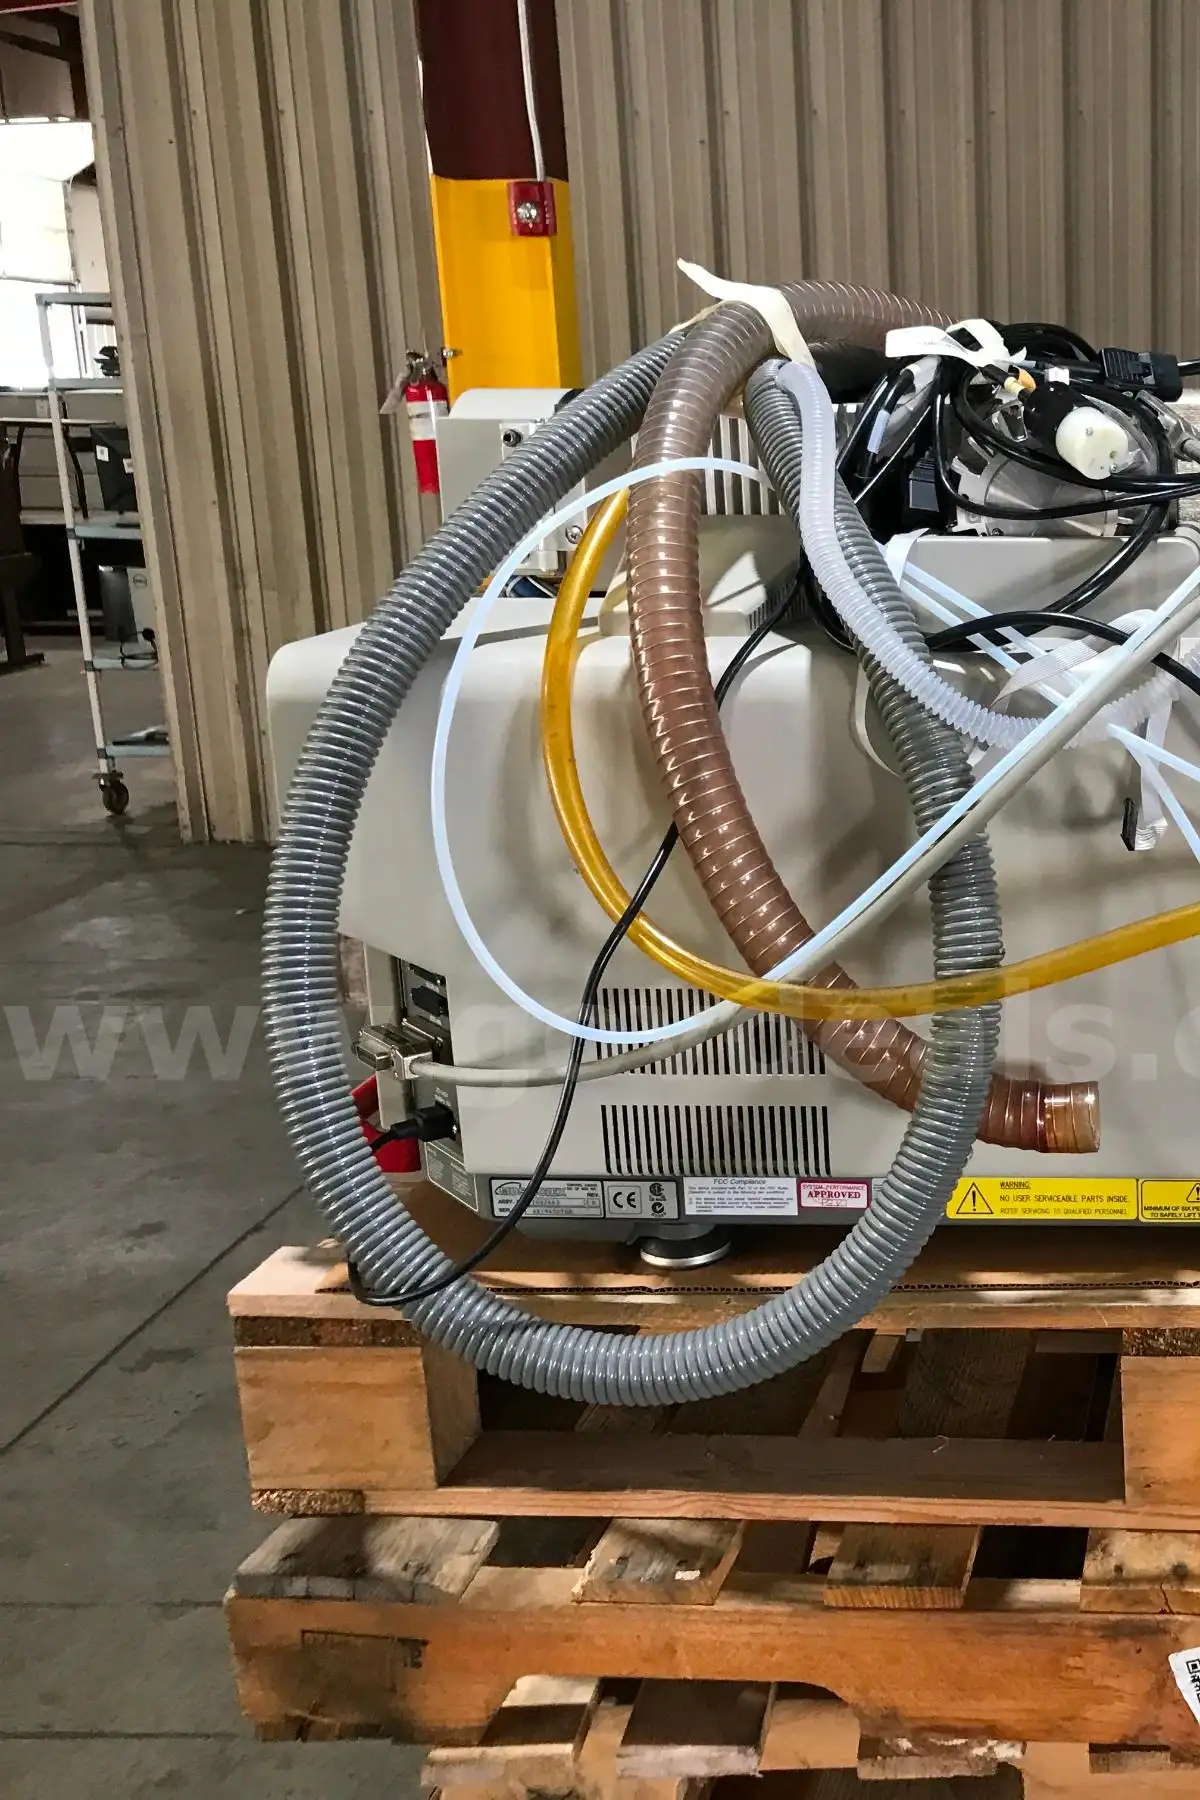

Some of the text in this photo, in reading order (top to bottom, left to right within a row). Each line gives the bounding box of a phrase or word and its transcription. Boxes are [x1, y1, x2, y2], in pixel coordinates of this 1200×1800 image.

[730, 1178, 767, 1186] Compliance
[808, 1190, 861, 1198] APPROVED
[1000, 1194, 1010, 1202] NO
[1013, 1194, 1031, 1202] USER
[613, 1191, 637, 1208] CE
